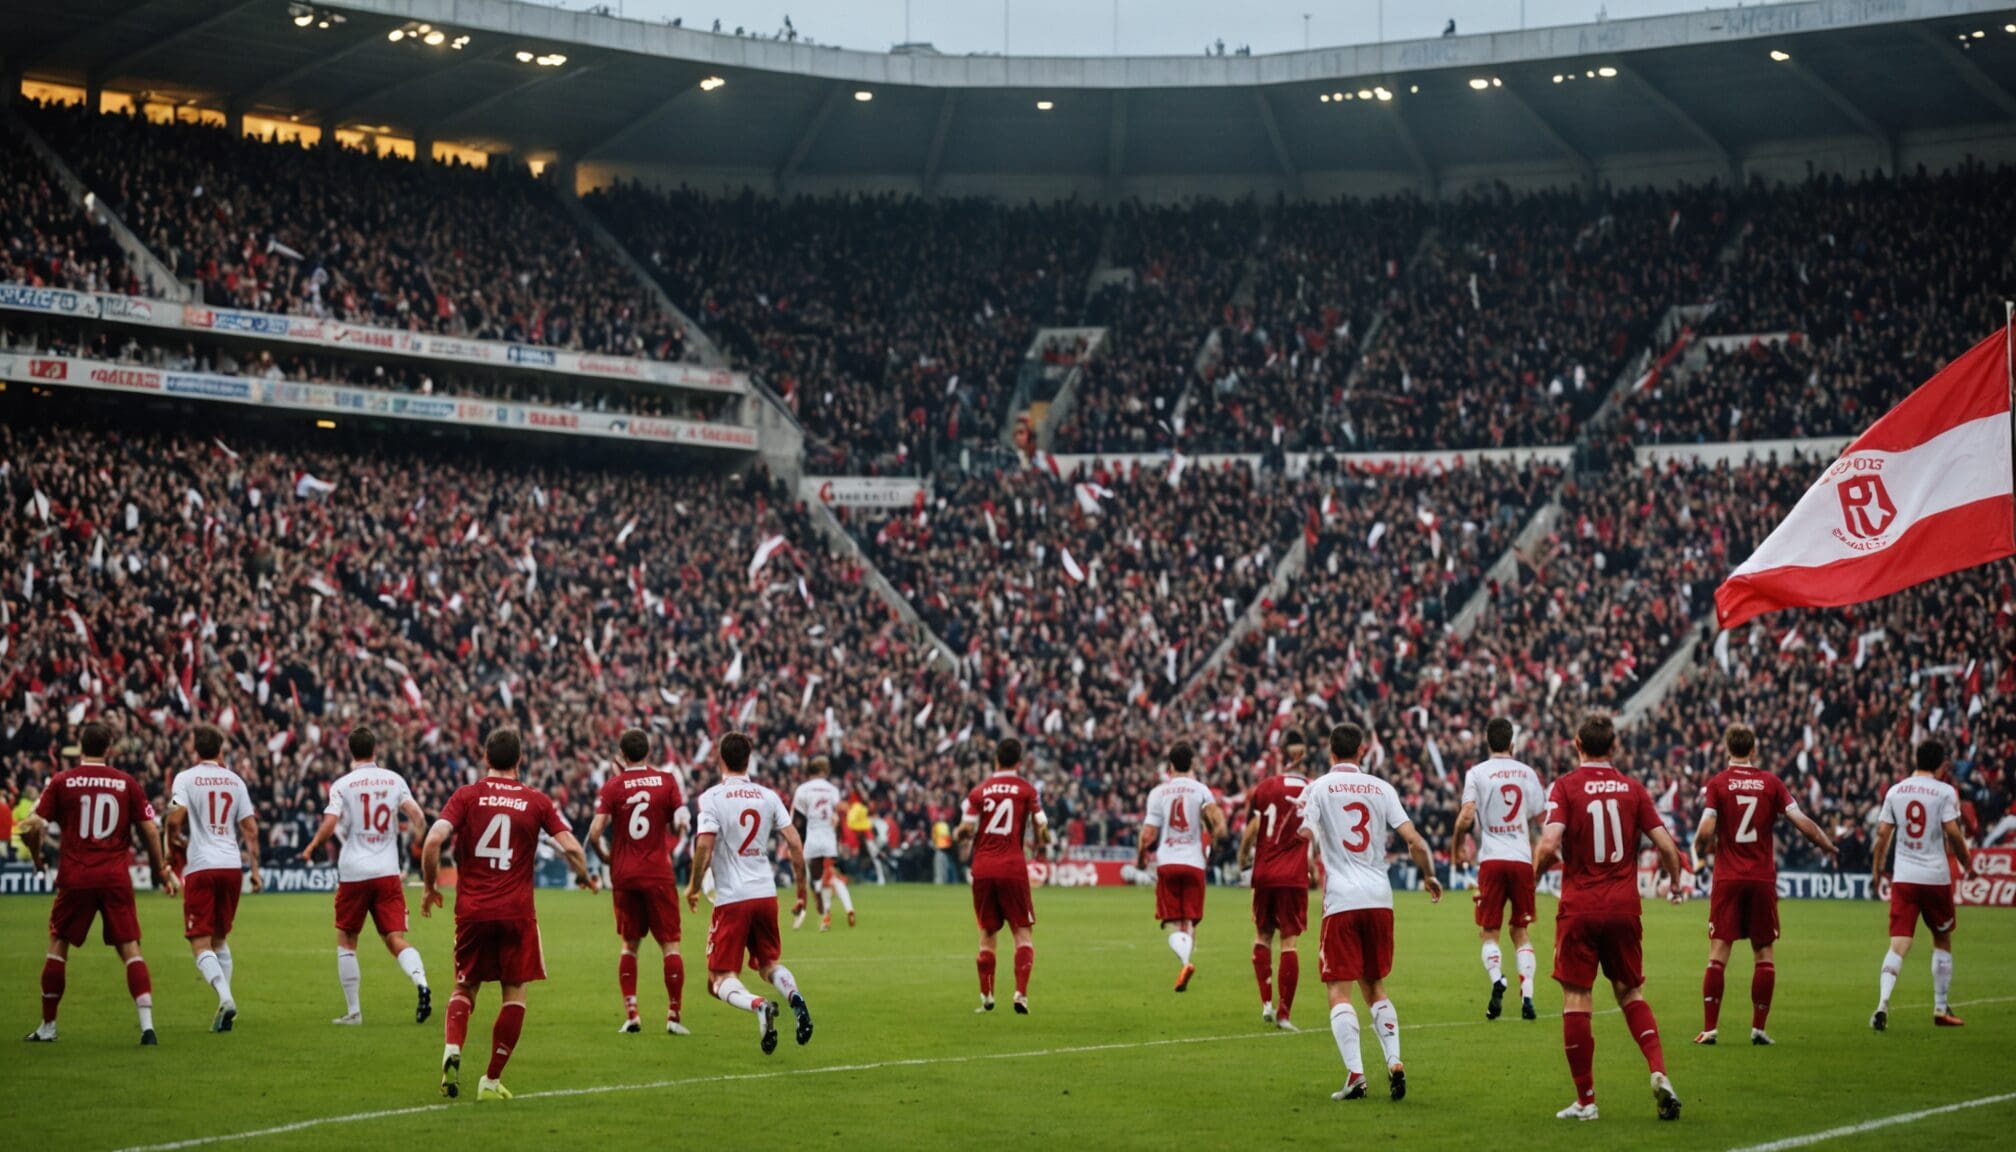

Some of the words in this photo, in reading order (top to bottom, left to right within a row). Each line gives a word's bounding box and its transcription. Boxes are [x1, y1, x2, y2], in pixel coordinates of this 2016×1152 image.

[79, 794, 119, 840] 10
[738, 804, 762, 852] 2
[1341, 801, 1370, 852] 3
[1586, 799, 1624, 864] 11
